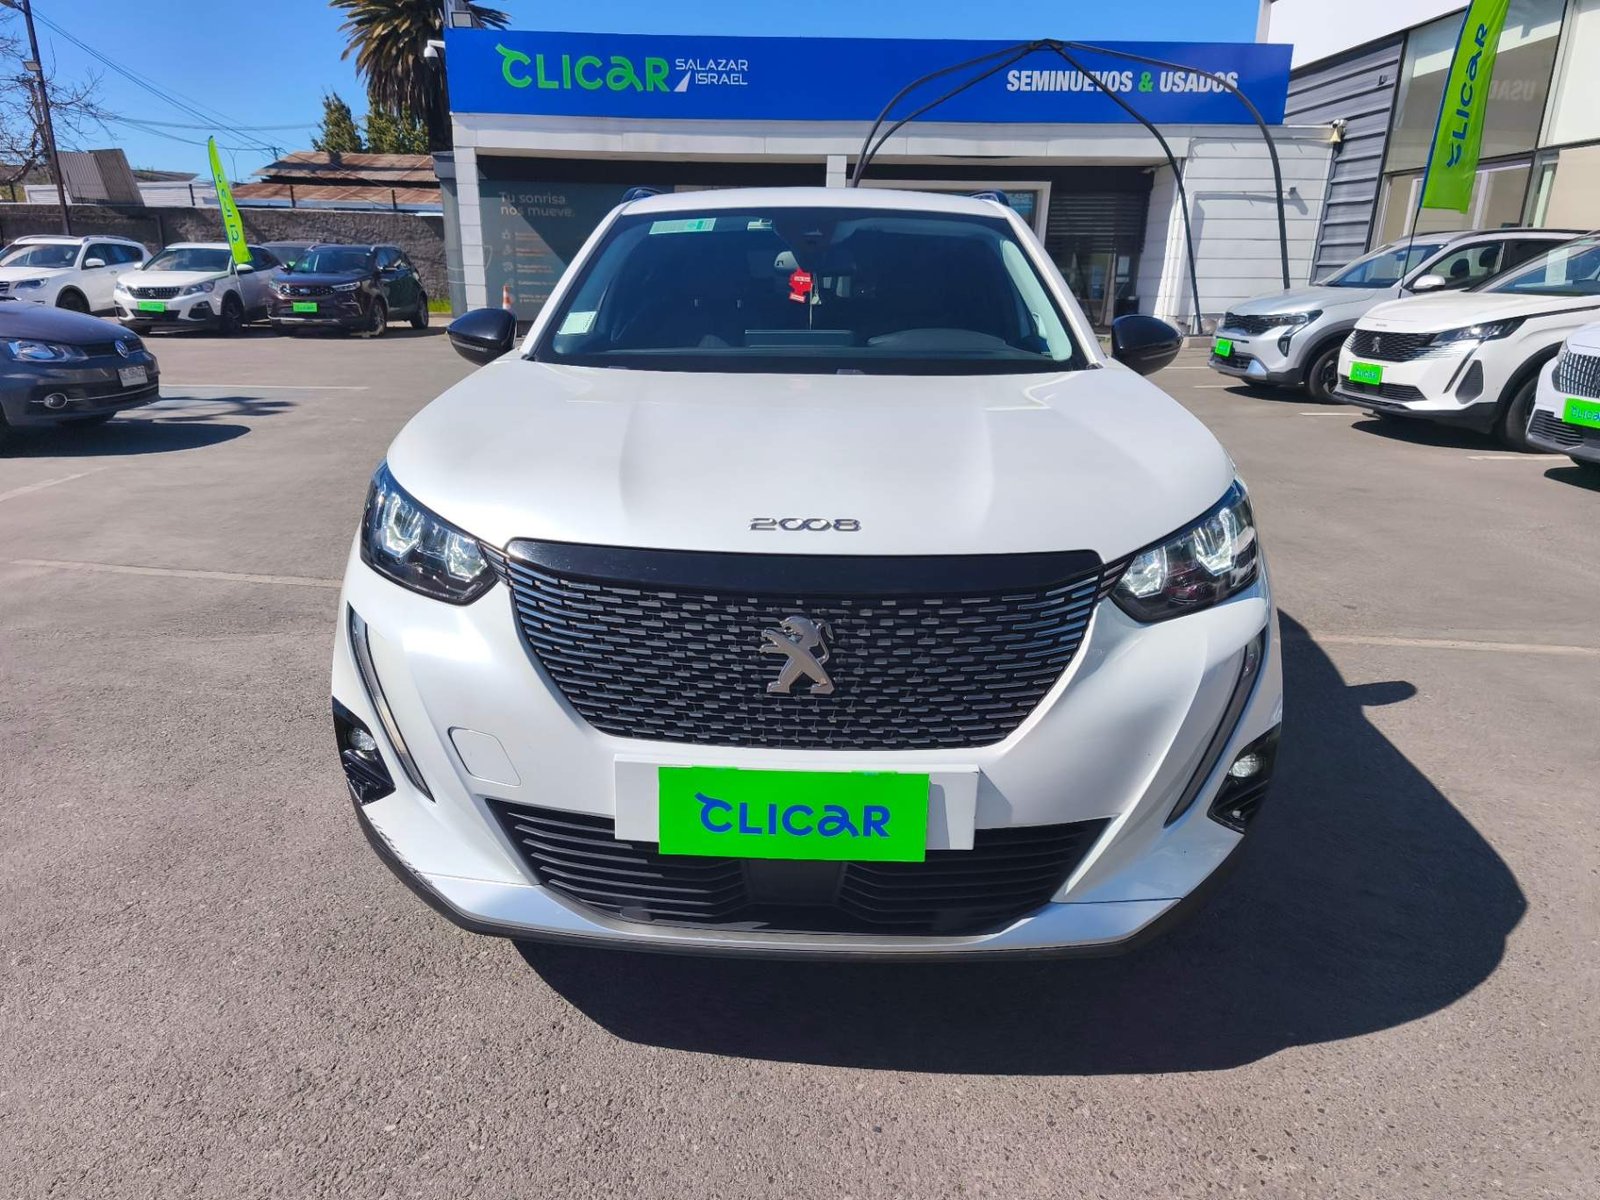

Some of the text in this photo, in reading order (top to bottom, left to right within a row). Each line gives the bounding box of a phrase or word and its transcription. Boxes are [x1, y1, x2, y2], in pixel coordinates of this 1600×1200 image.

[675, 58, 748, 72] SALAZAR
[695, 72, 748, 85] ISRAEL
[1006, 70, 1239, 93] SEMINUEVOS & USADOS
[499, 191, 566, 205] Tu sonrisa
[500, 206, 523, 217] nos
[750, 517, 861, 532] 2008
